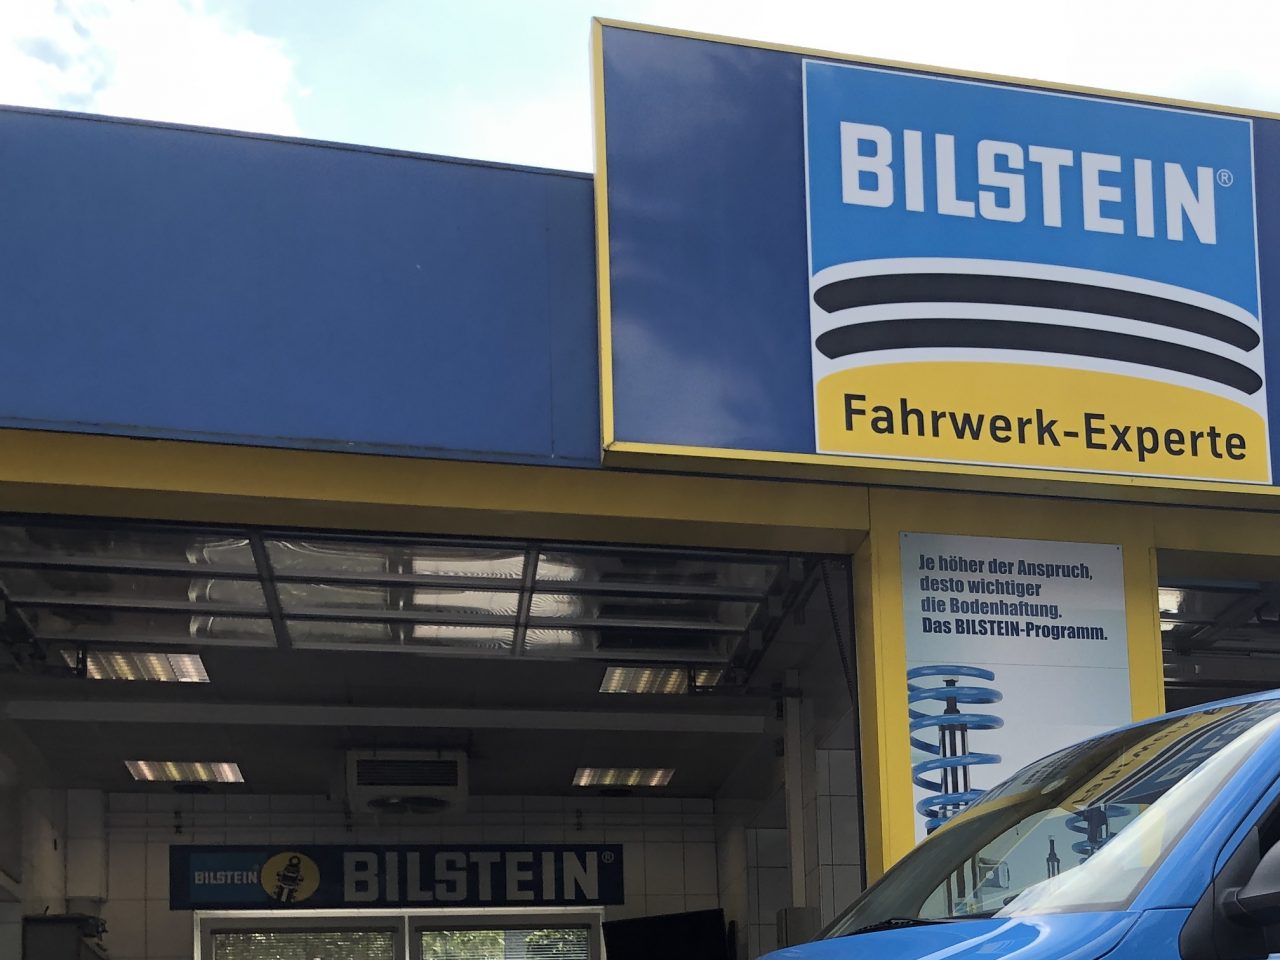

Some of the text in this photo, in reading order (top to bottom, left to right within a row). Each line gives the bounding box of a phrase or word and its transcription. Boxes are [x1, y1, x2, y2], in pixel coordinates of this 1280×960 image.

[844, 393, 1247, 461] Fahrwerk-Experte
[919, 554, 1093, 581] Je höher der Anspruch,
[920, 576, 1041, 597] desto wichtiger
[921, 597, 1062, 619] die Bodenhaftung.
[922, 618, 1108, 641] Das BILSTEIN-Programm.
[194, 871, 258, 885] BILSTEIN
